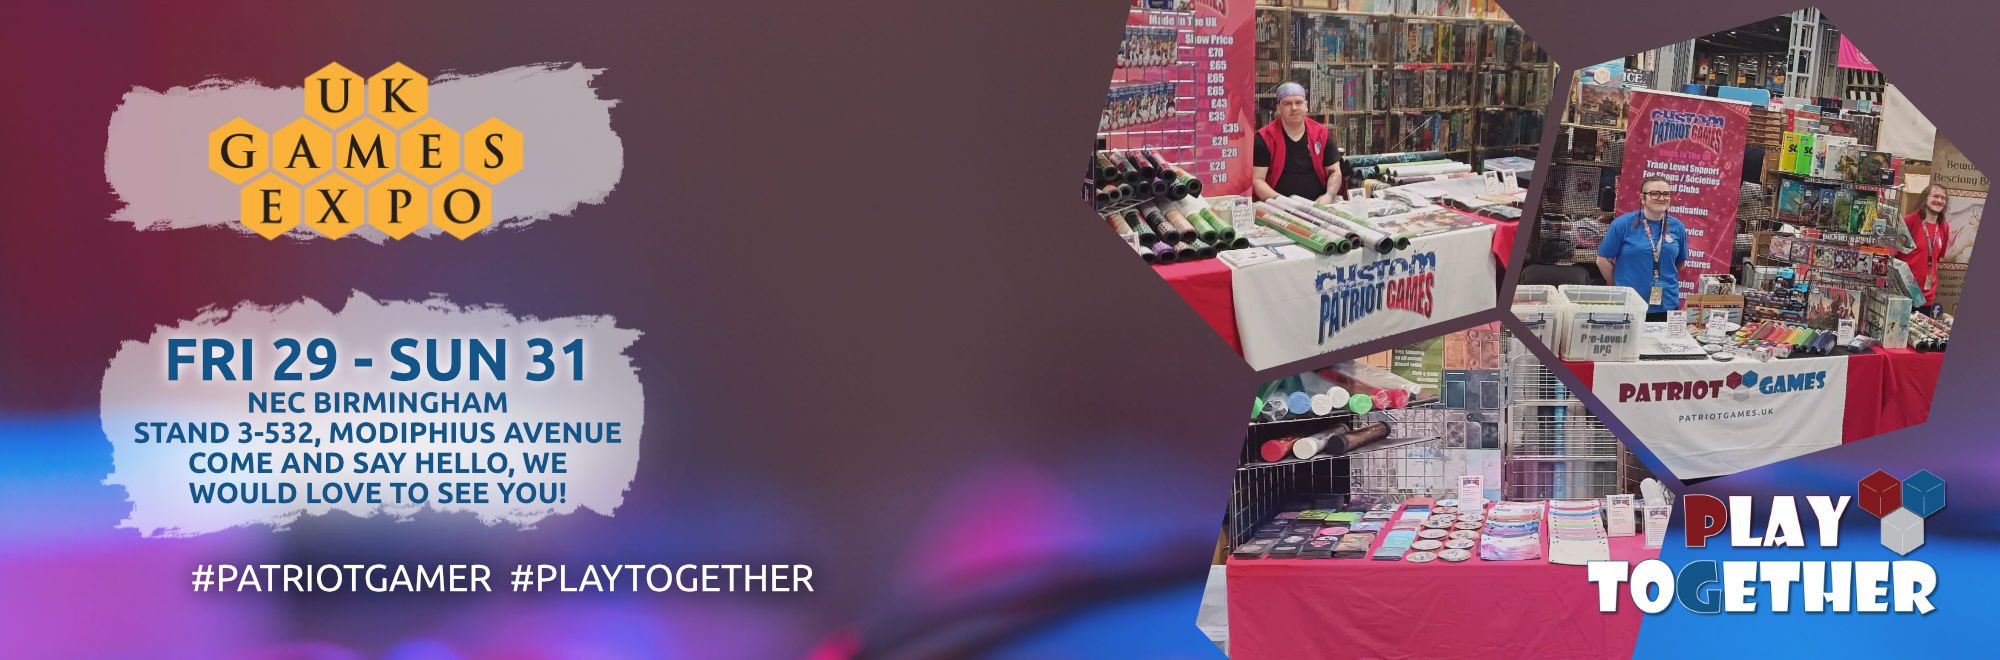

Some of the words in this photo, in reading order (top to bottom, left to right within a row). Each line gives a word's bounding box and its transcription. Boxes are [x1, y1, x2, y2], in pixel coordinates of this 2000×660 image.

[1205, 17, 1217, 27] UK
[1211, 35, 1234, 45] Price
[1208, 47, 1223, 57] £70
[1210, 60, 1227, 70] £65
[1207, 73, 1224, 83] £65
[1207, 86, 1224, 96] £65
[1211, 98, 1228, 108] £43
[1208, 111, 1225, 121] £35
[1222, 123, 1239, 133] £35
[1212, 136, 1228, 146] £28
[1650, 120, 1691, 147] PATRIOT
[1691, 124, 1722, 153] GAMES
[1210, 161, 1225, 171] £28
[1647, 160, 1668, 170] Trade
[1669, 162, 1688, 172] Level
[1690, 165, 1719, 175] Support
[1212, 173, 1227, 183] £18
[1643, 170, 1655, 178] For
[1656, 172, 1679, 182] Shops
[1685, 175, 1720, 185] Societies
[1679, 185, 1699, 194] Clubs
[1688, 249, 1704, 257] Your
[1318, 282, 1385, 345] PATRIOT
[1386, 271, 1434, 319] GAMES
[1619, 380, 1724, 403] PATRIOT
[1759, 371, 1826, 394] GAMES
[1678, 408, 1774, 423] PATRIOTGAMES.UK
